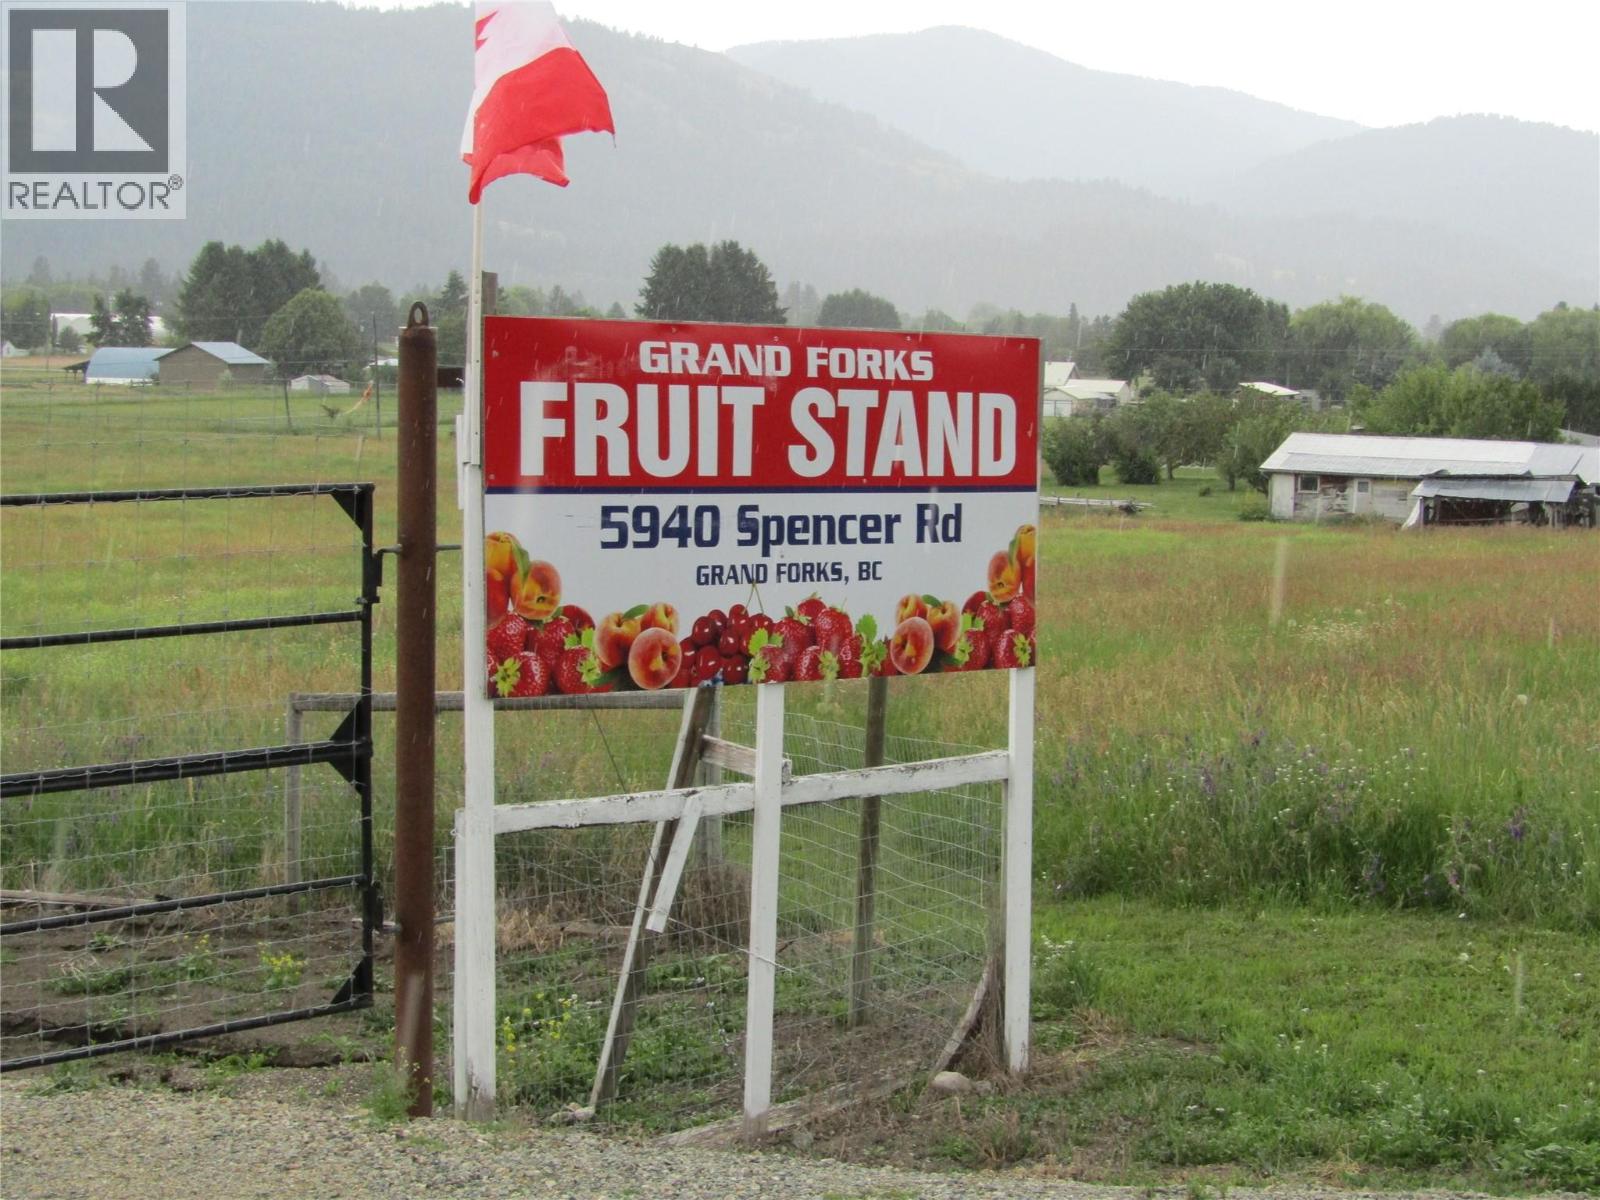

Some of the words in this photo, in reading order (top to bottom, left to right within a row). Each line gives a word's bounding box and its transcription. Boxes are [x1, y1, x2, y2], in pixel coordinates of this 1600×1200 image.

[639, 340, 791, 378] GRAND
[806, 346, 934, 381] FORKS
[519, 381, 766, 478] FRUIT
[787, 387, 1017, 478] STAND
[600, 504, 720, 550] 5940
[737, 504, 902, 558] Spencer
[915, 502, 962, 544] Rd
[696, 562, 769, 586] GRAND
[776, 561, 850, 585] FORKS,
[857, 561, 883, 582] BC
